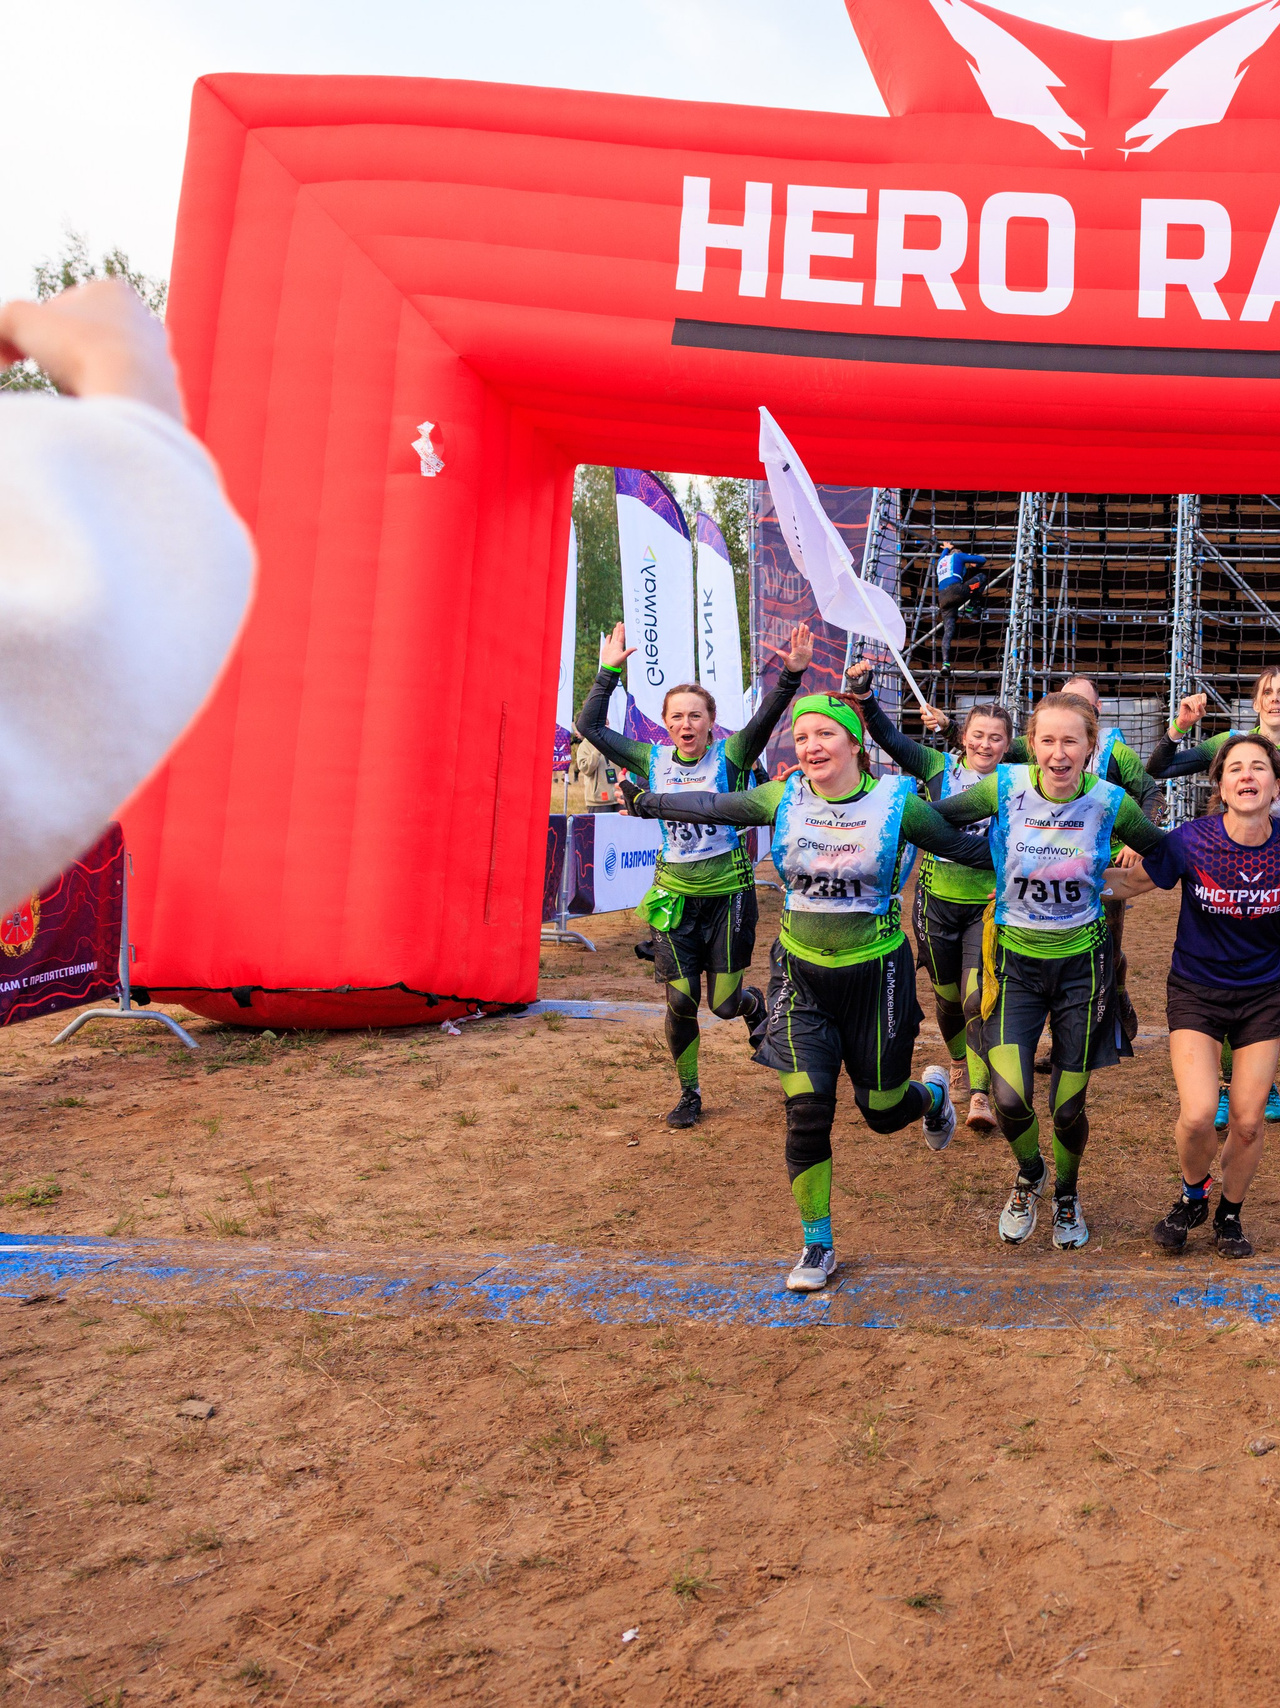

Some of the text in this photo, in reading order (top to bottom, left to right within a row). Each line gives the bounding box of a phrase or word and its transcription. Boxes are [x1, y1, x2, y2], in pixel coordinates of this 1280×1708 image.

[675, 176, 1077, 316] HERO
[805, 817, 867, 828] ГОНКА ГЕРОЕВ
[1024, 817, 1085, 828] ГОНКА ГЕРОЕВ
[797, 837, 858, 854] Greenway
[1015, 841, 1076, 858] Greenway
[1013, 877, 1082, 903] 7315
[1201, 903, 1243, 915] ГОНКА
[22, 977, 29, 987] С
[30, 960, 98, 986] ПРЕПЯТСТВИЯМИ
